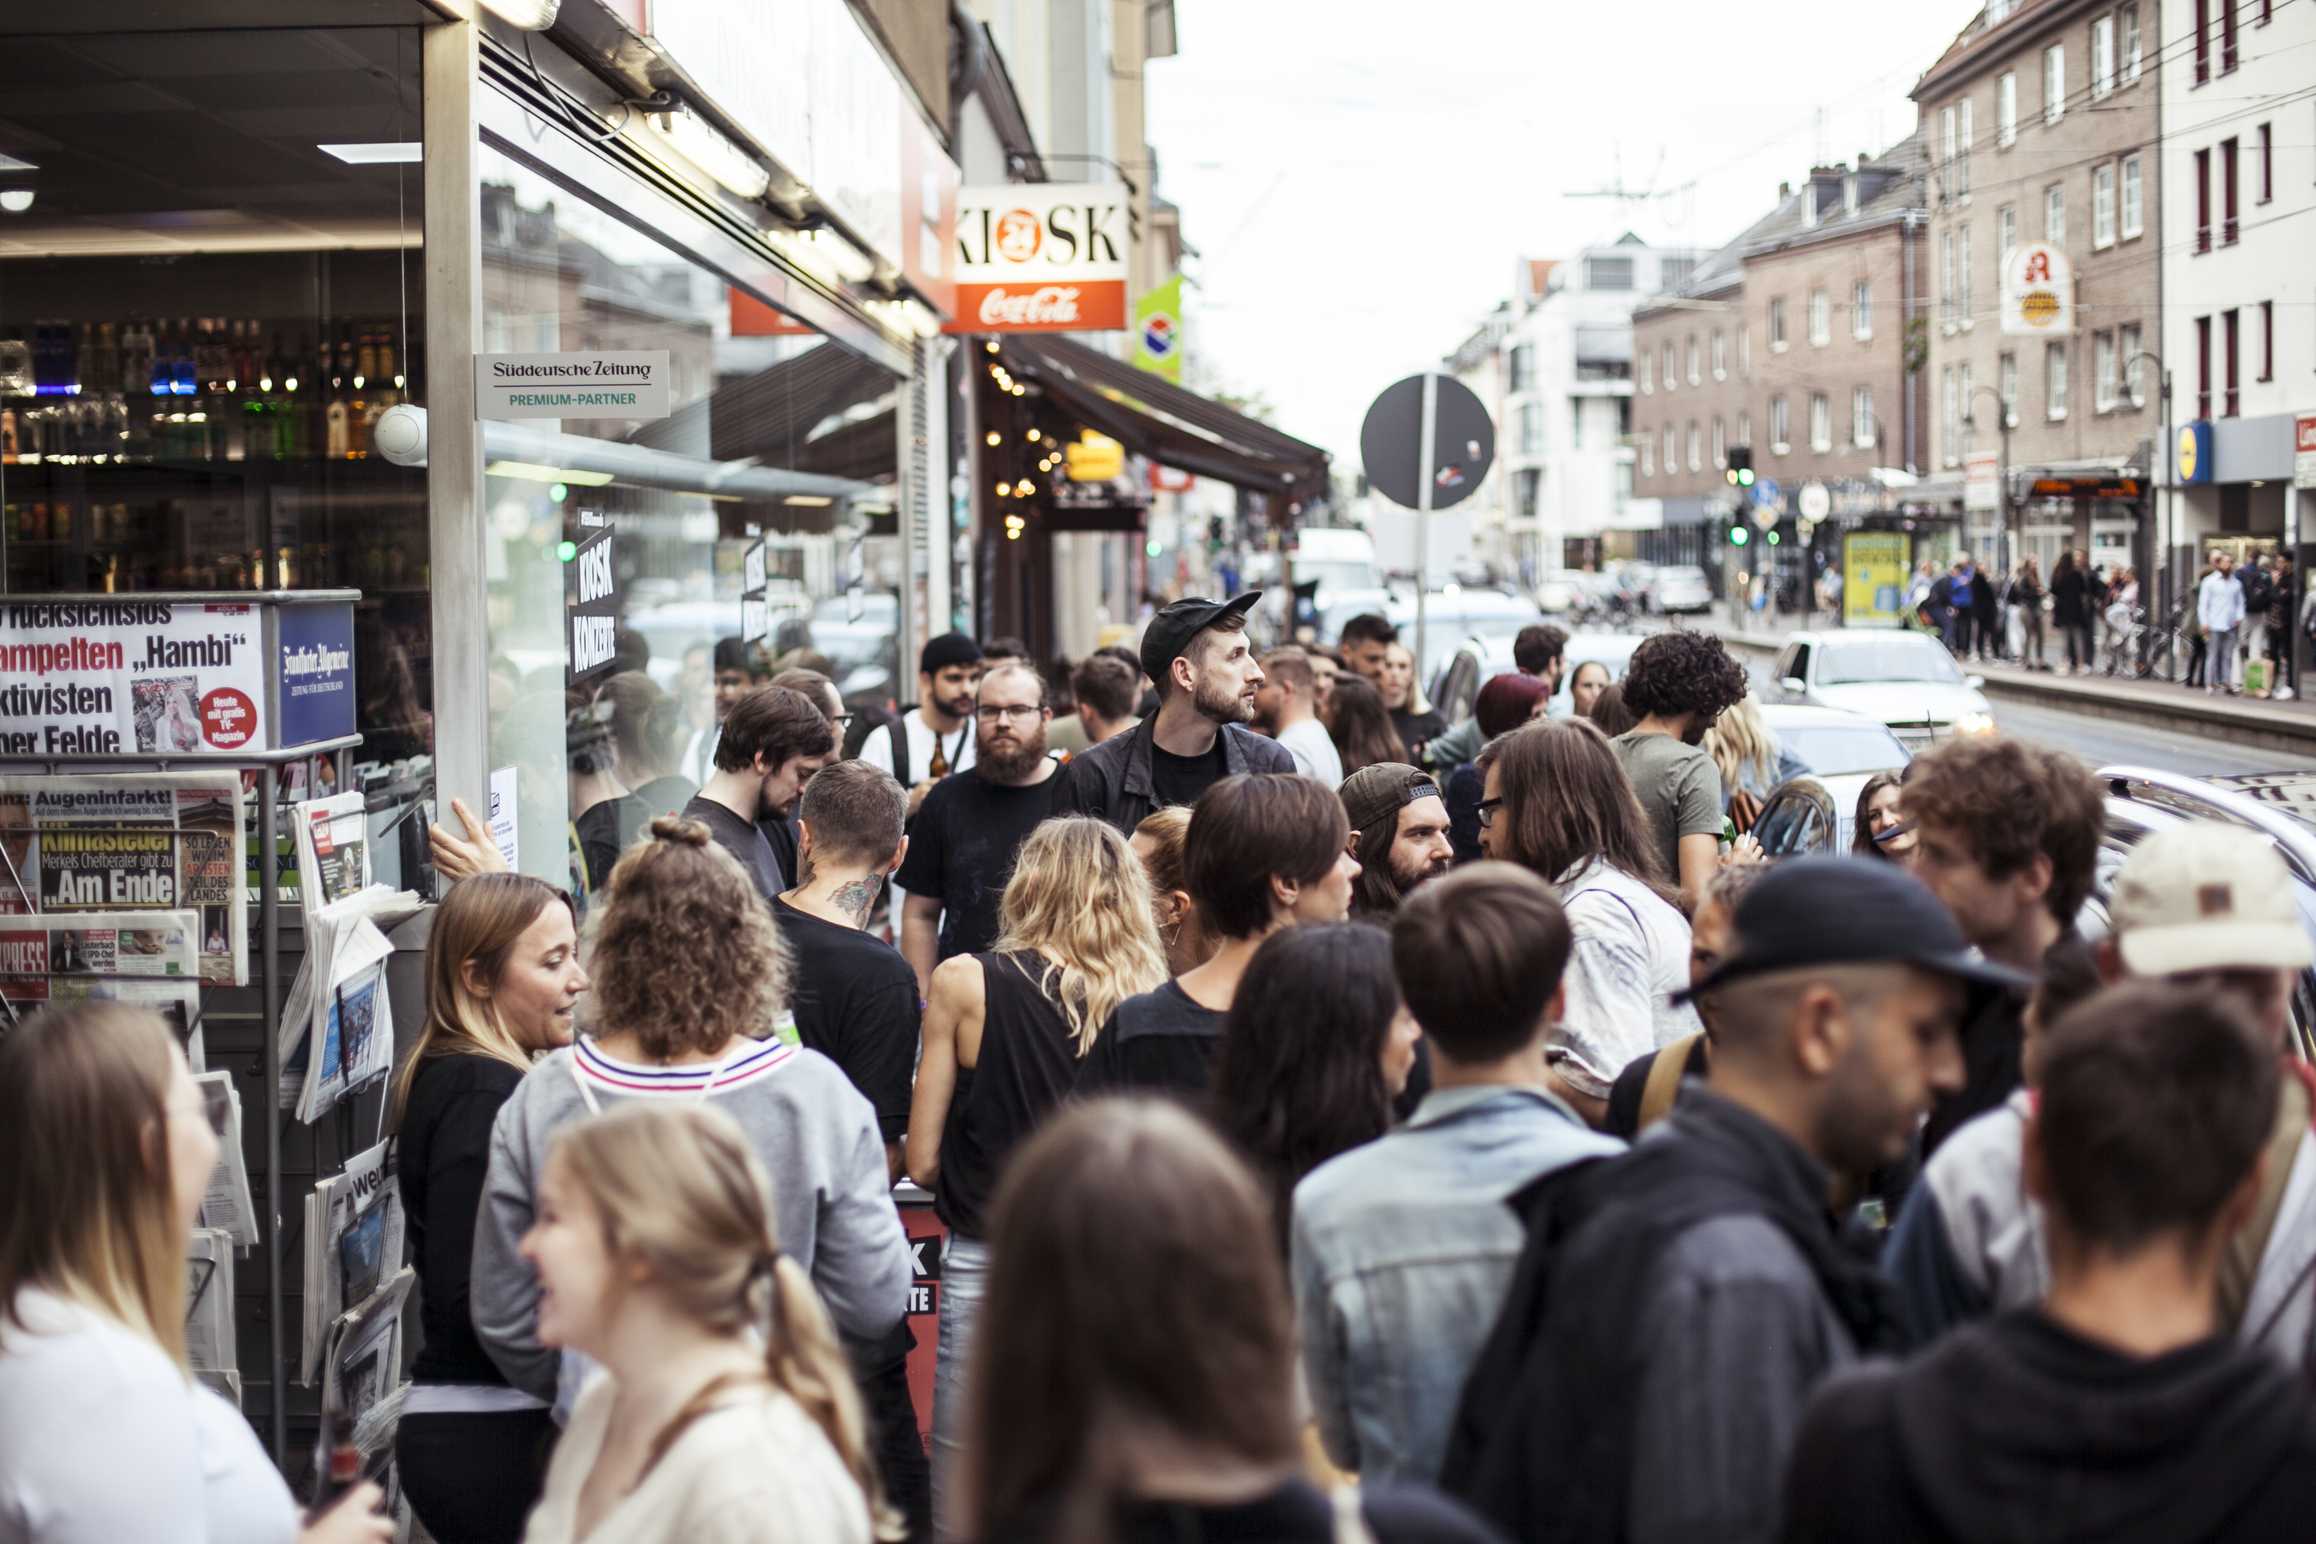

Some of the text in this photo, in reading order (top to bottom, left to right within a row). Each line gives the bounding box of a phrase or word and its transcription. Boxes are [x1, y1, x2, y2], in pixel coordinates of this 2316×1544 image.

[493, 360, 652, 380] Süddeutsche Zeitung
[509, 392, 637, 407] PREMIUM-PARTNER
[579, 536, 614, 604] KIOSK
[573, 616, 616, 674] KONZERTE
[212, 696, 238, 707] Heute
[207, 707, 246, 720] mit gratis
[44, 724, 121, 752] Felde
[211, 730, 246, 743] Magazin
[34, 789, 171, 808] Augeninfarkt!
[42, 852, 174, 871] Merkels Chefberater gibt zu
[109, 868, 174, 904] Ende
